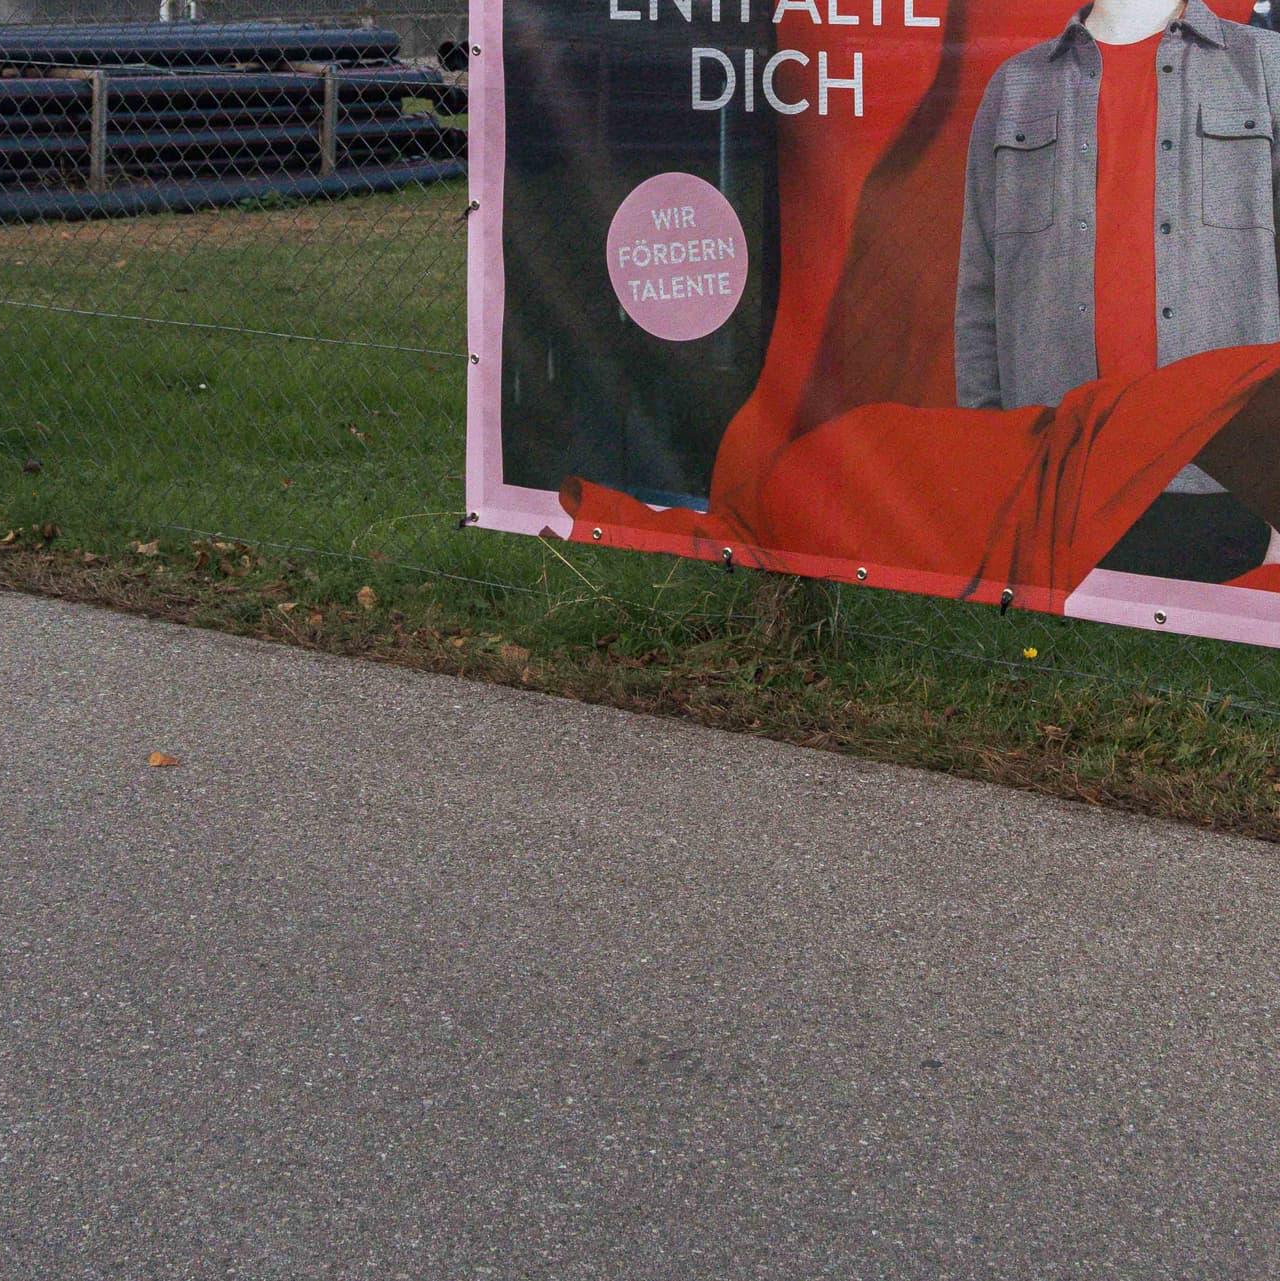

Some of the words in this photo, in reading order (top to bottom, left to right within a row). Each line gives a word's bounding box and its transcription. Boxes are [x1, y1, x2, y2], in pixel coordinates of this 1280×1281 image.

[690, 48, 865, 117] DICH
[651, 206, 698, 231] WIR
[618, 237, 736, 268] FÖRDERN
[627, 272, 733, 303] TALENTE
